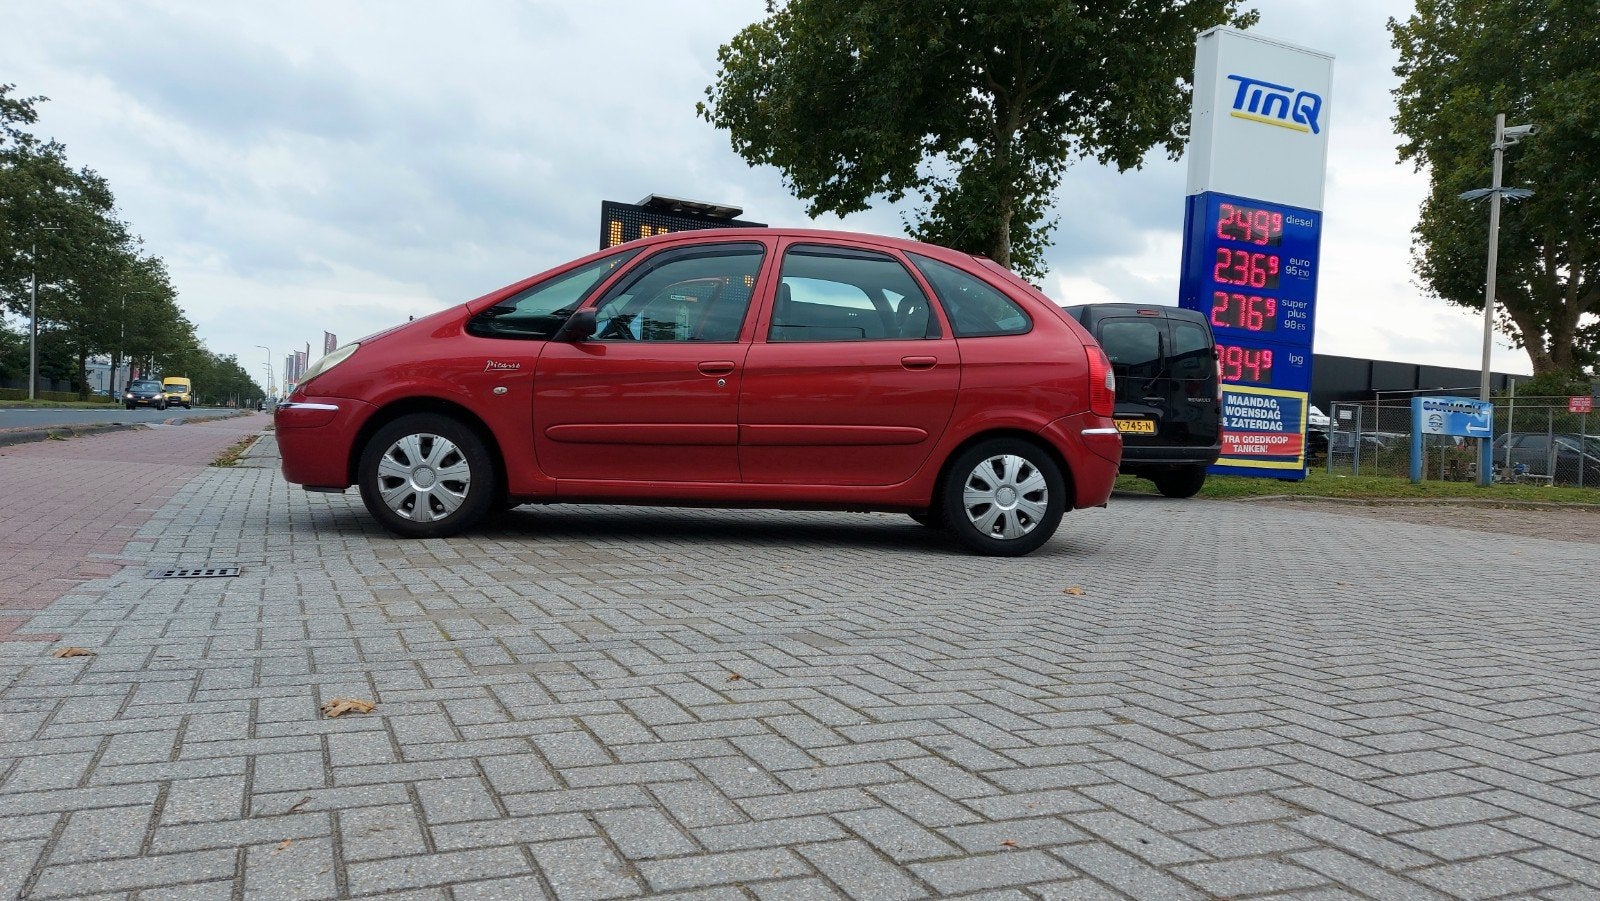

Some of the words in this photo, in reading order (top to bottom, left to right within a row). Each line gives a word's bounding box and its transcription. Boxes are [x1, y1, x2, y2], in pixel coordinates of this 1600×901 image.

[1228, 75, 1322, 134] TinQ
[1286, 215, 1313, 228] diesel
[1290, 257, 1310, 267] euro
[1285, 265, 1297, 276] 95
[1282, 300, 1307, 309] super
[1287, 309, 1307, 319] plus
[1284, 319, 1297, 330] 98
[1289, 353, 1304, 365] lpg
[1227, 395, 1280, 410] MAANDAG,
[1225, 406, 1281, 420] WOENSDAG
[1222, 417, 1229, 427] &
[1231, 418, 1283, 431] ZATERDAG
[1223, 435, 1240, 444] TRA
[1242, 436, 1289, 444] GOEDKOOP
[1233, 445, 1268, 453] TANKEN!
